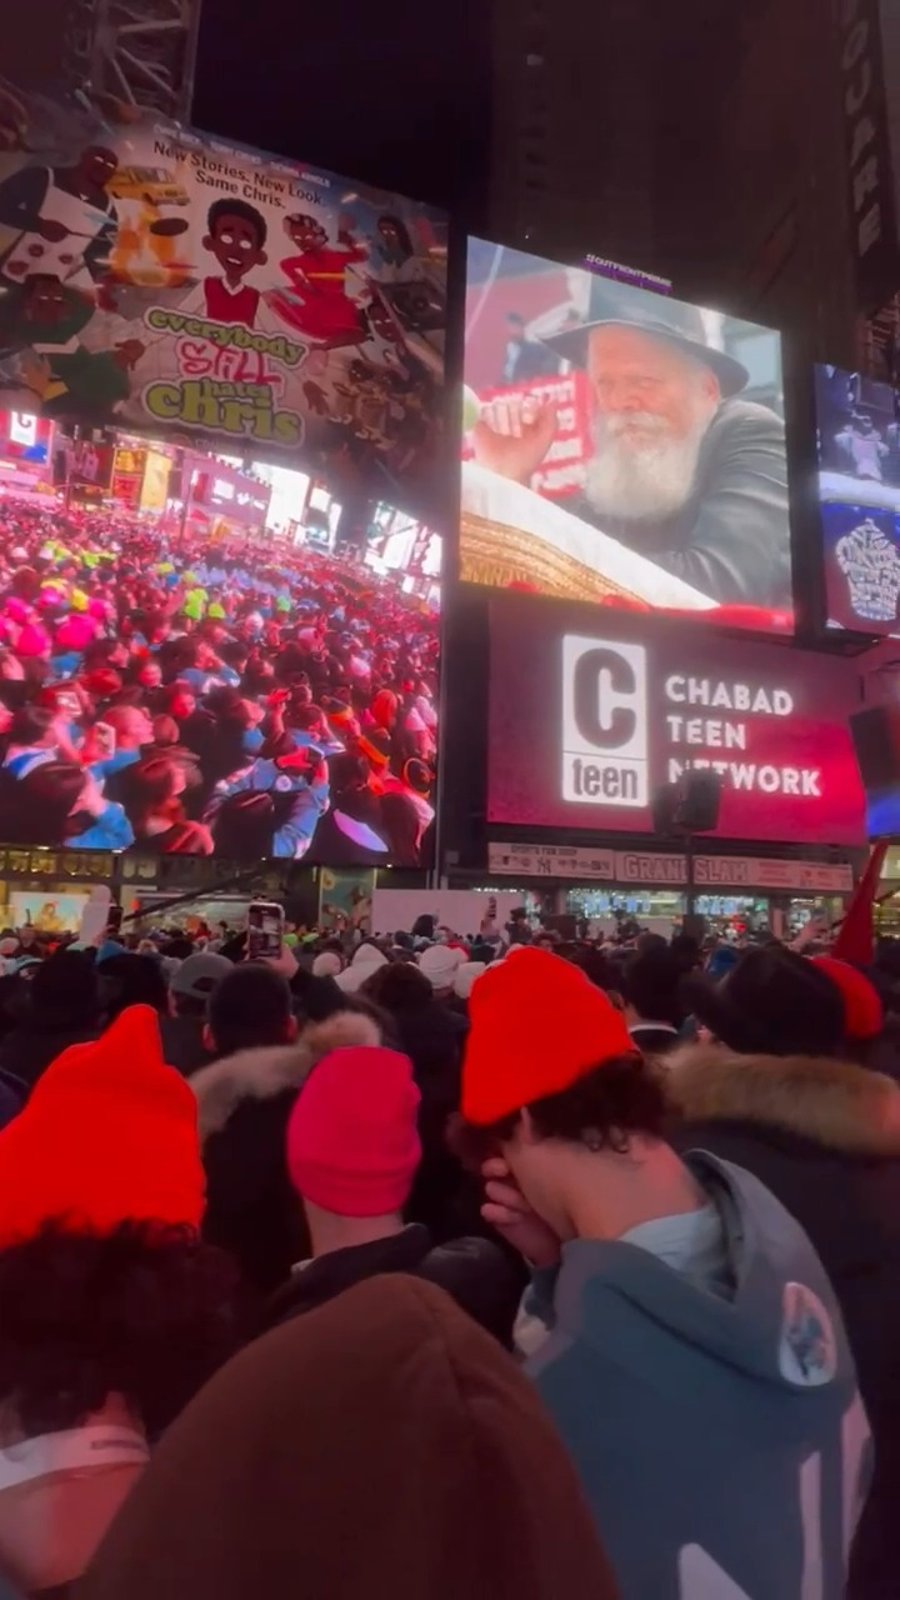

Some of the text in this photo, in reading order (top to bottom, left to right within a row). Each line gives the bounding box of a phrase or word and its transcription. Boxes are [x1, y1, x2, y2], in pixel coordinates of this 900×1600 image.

[154, 141, 187, 162] New
[190, 152, 250, 183] Stories.
[254, 172, 286, 193] New
[195, 170, 286, 209] Same Chris.
[147, 308, 306, 366] everybody
[573, 648, 637, 750] C
[665, 675, 794, 717] CHABAD
[666, 715, 746, 750] TEEN
[572, 758, 638, 800] teen
[695, 859, 748, 882] SLAM
